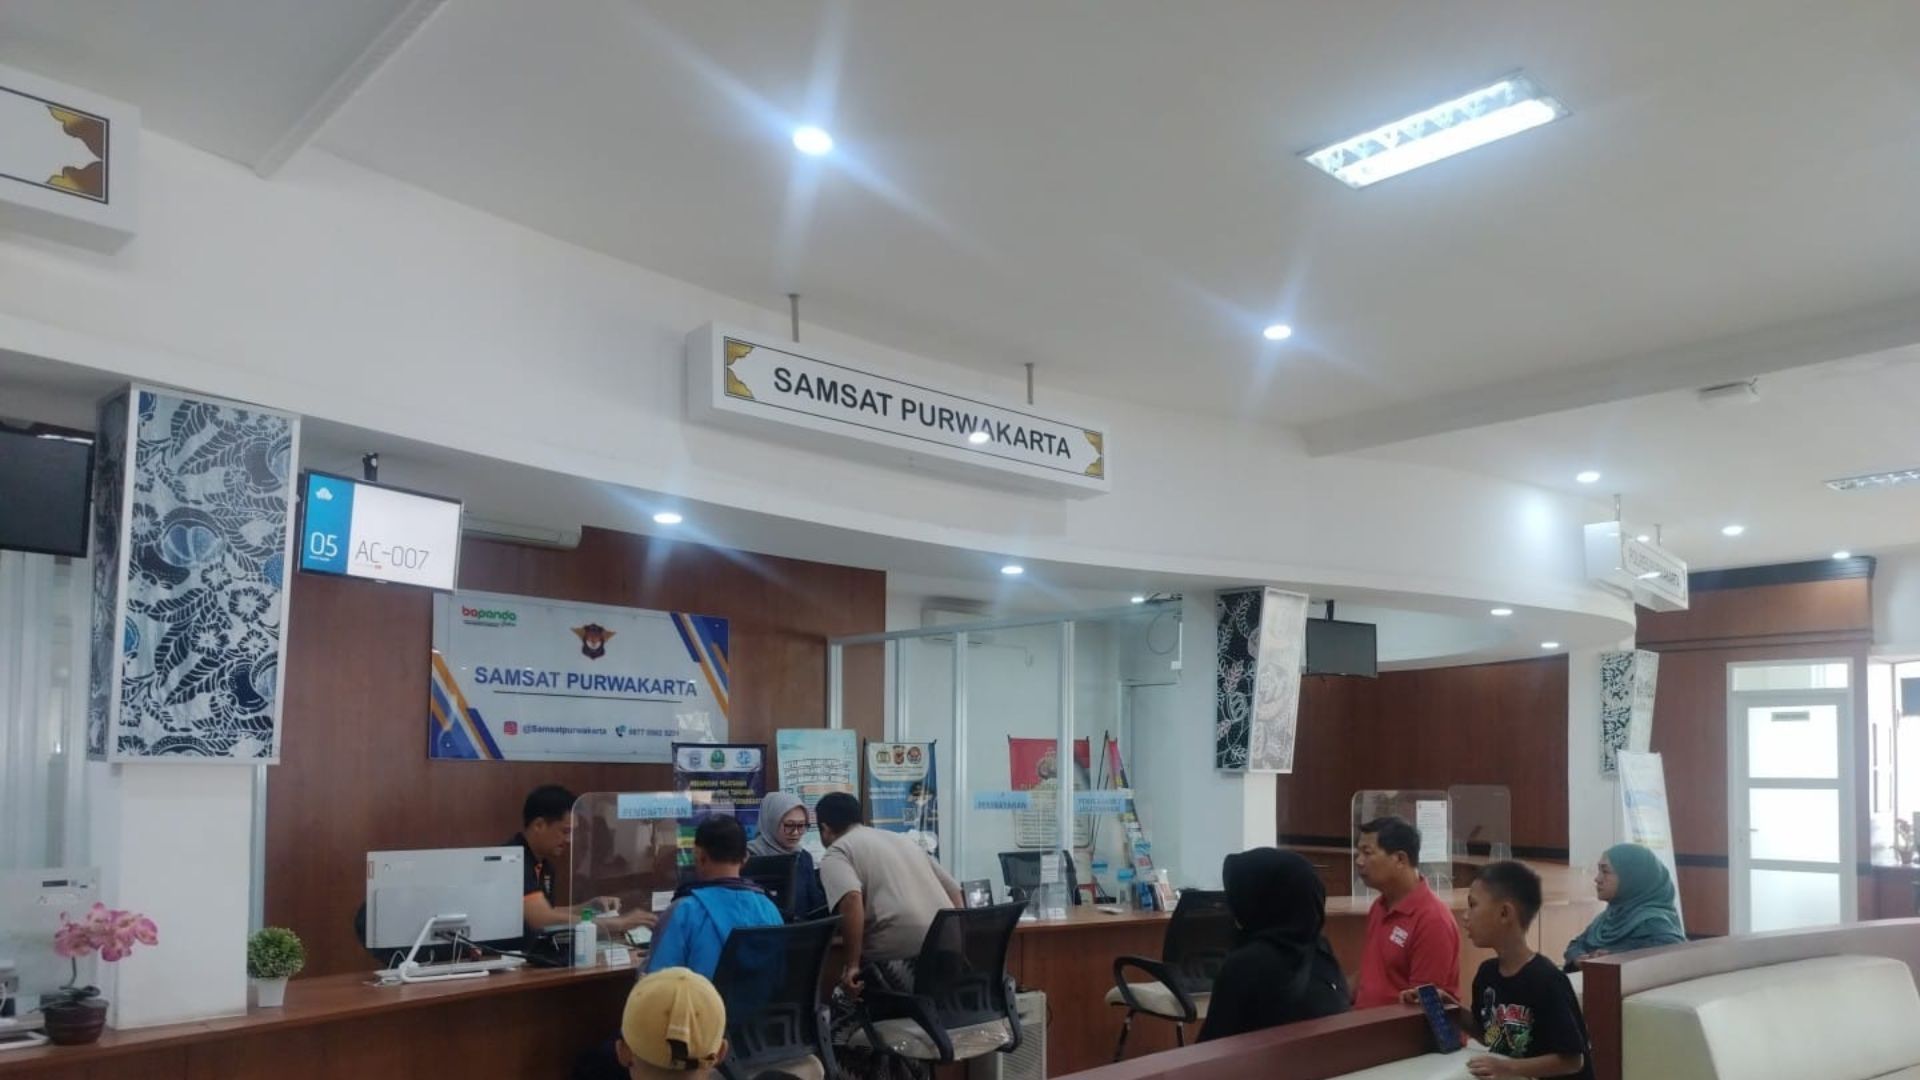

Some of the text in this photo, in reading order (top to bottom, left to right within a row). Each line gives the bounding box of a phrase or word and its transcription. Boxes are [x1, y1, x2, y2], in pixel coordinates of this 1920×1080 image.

[773, 366, 1072, 459] SAMSAT PURWAKARTA
[310, 531, 338, 558] 05
[355, 540, 429, 570] AC-007
[474, 666, 698, 697] SAMSAT PURWAKARTA
